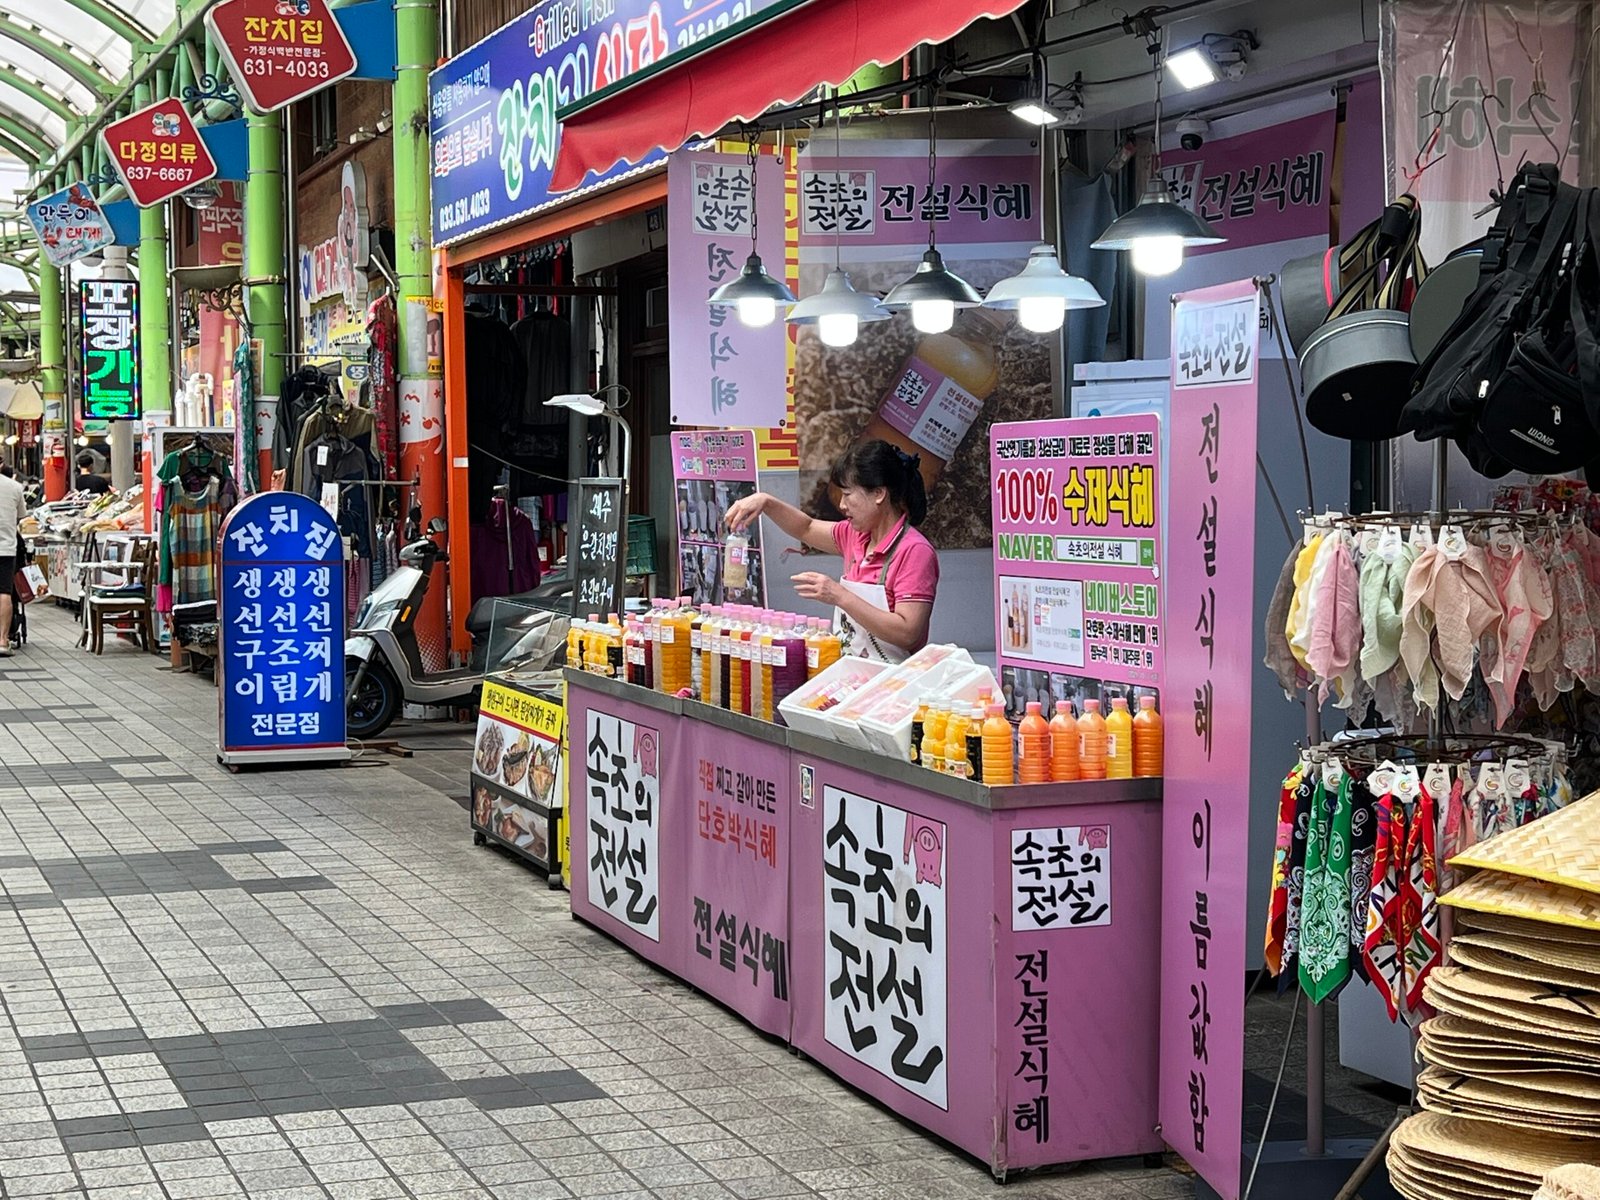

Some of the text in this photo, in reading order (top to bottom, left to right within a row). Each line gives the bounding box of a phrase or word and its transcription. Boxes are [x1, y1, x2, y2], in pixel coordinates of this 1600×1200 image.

[244, 17, 323, 44] 잔치집
[244, 58, 329, 78] 631-4033
[120, 141, 198, 164] 다정의류
[126, 166, 193, 181] 637-6667
[439, 188, 490, 231] 033.631.4033
[804, 173, 867, 203] 속초의
[880, 184, 1032, 222] 전설식혜
[1199, 152, 1324, 222] 전설식혜
[808, 203, 872, 231] 전설
[1093, 435, 1115, 455] 정성을
[997, 463, 1154, 527] 100% 수제식혜
[230, 506, 337, 561] 잔치집
[998, 534, 1055, 561] NAVER
[1084, 582, 1158, 617] 네이버스토어
[1194, 403, 1220, 763] 전설식혜
[233, 568, 266, 705] 생선구이
[268, 567, 301, 703] 생선조림
[303, 566, 333, 703] 생선찌개
[251, 712, 321, 736] 전문점
[587, 717, 652, 828] 속초의
[698, 759, 714, 793] 직접
[736, 772, 754, 807] 갈아
[756, 779, 776, 814] 만든
[698, 799, 777, 869] 단호박식혜
[1012, 828, 1102, 880] 속초의
[590, 818, 657, 925] 전설
[824, 797, 932, 954] 속초의
[1018, 879, 1110, 926] 전설
[693, 895, 789, 1002] 전설식혜
[829, 930, 944, 1084] 전설
[1014, 949, 1050, 1144] 전설식혜
